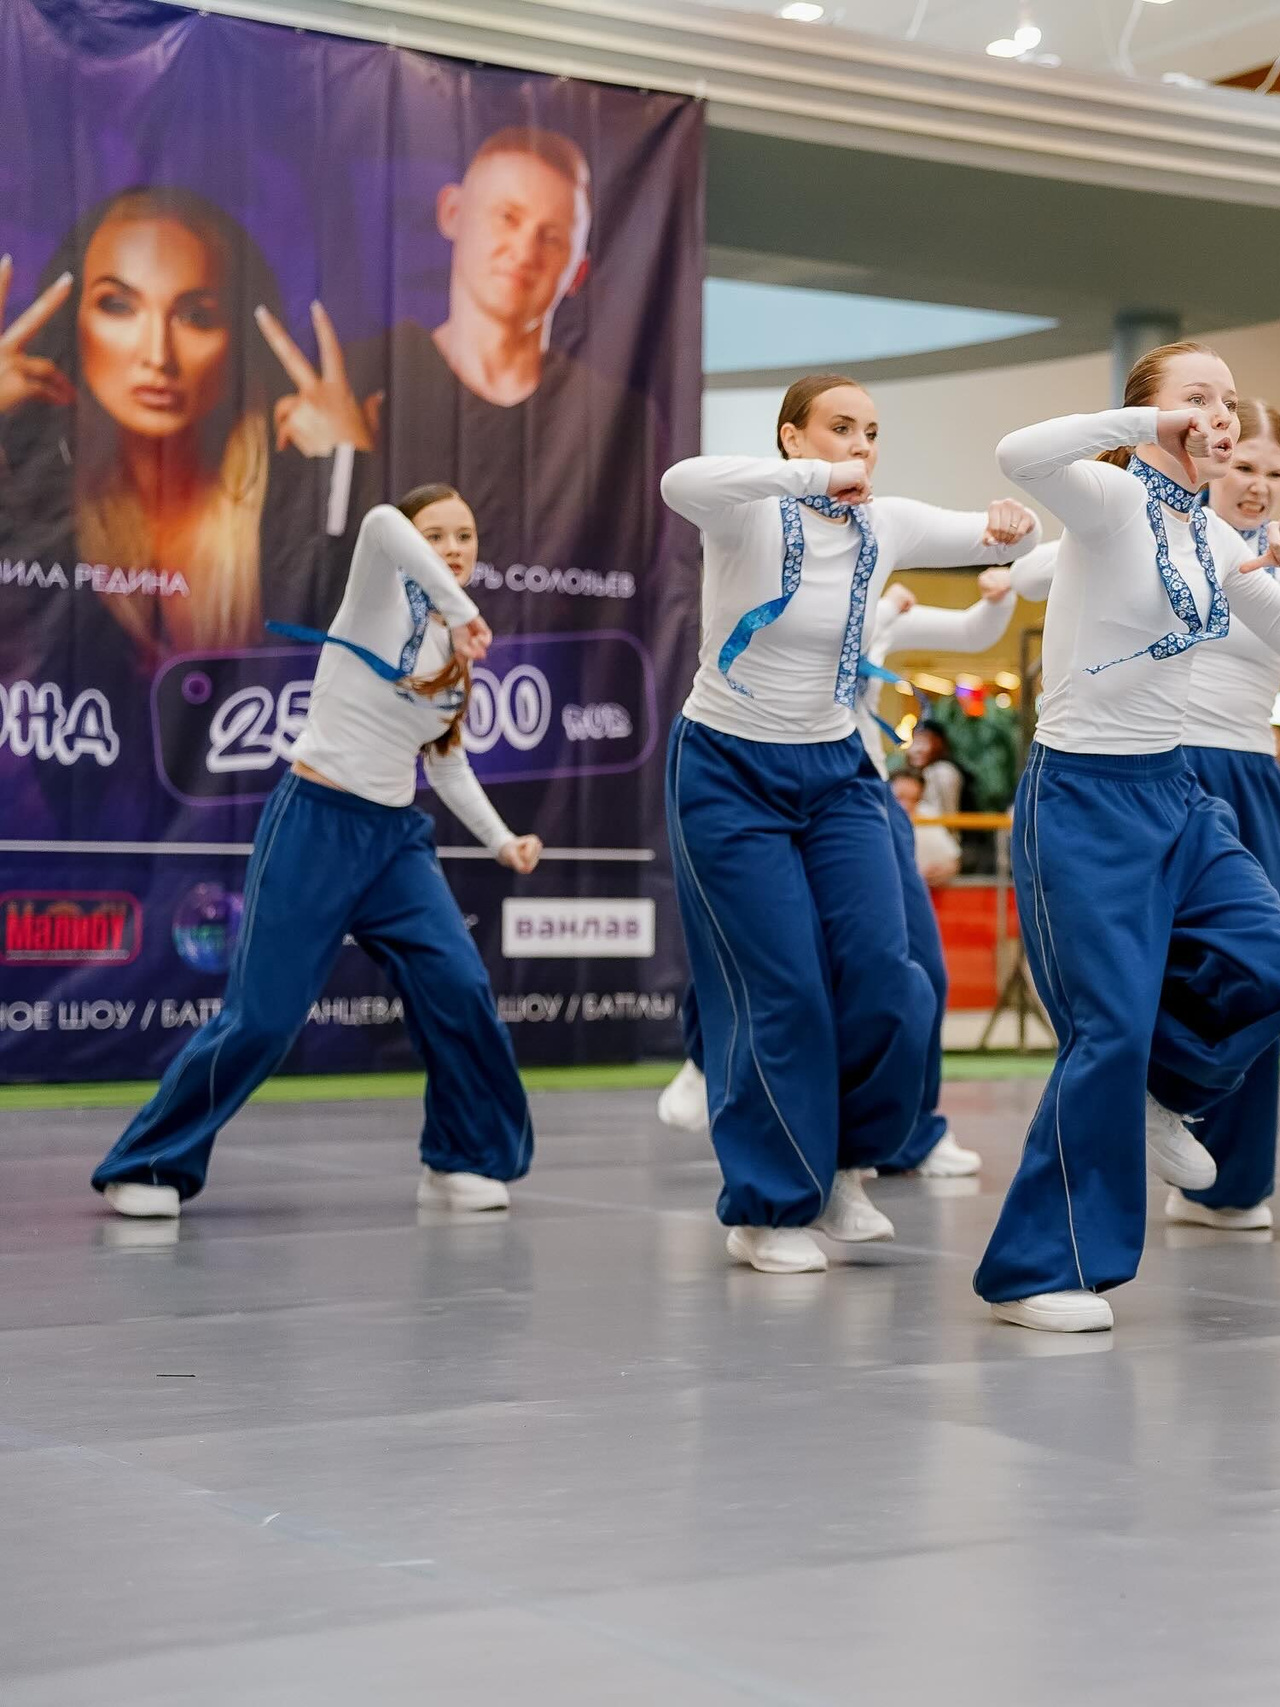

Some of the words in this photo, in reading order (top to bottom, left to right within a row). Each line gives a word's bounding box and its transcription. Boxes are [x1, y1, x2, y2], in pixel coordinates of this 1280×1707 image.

[0, 558, 69, 590] ИЛА
[74, 562, 191, 597] РЕДИНА
[0, 680, 120, 766] НД
[58, 998, 136, 1031] ШОУ
[140, 997, 157, 1031] /
[305, 995, 405, 1026] АНЦЕВА
[498, 992, 564, 1023] ШОУ
[564, 993, 582, 1023] /
